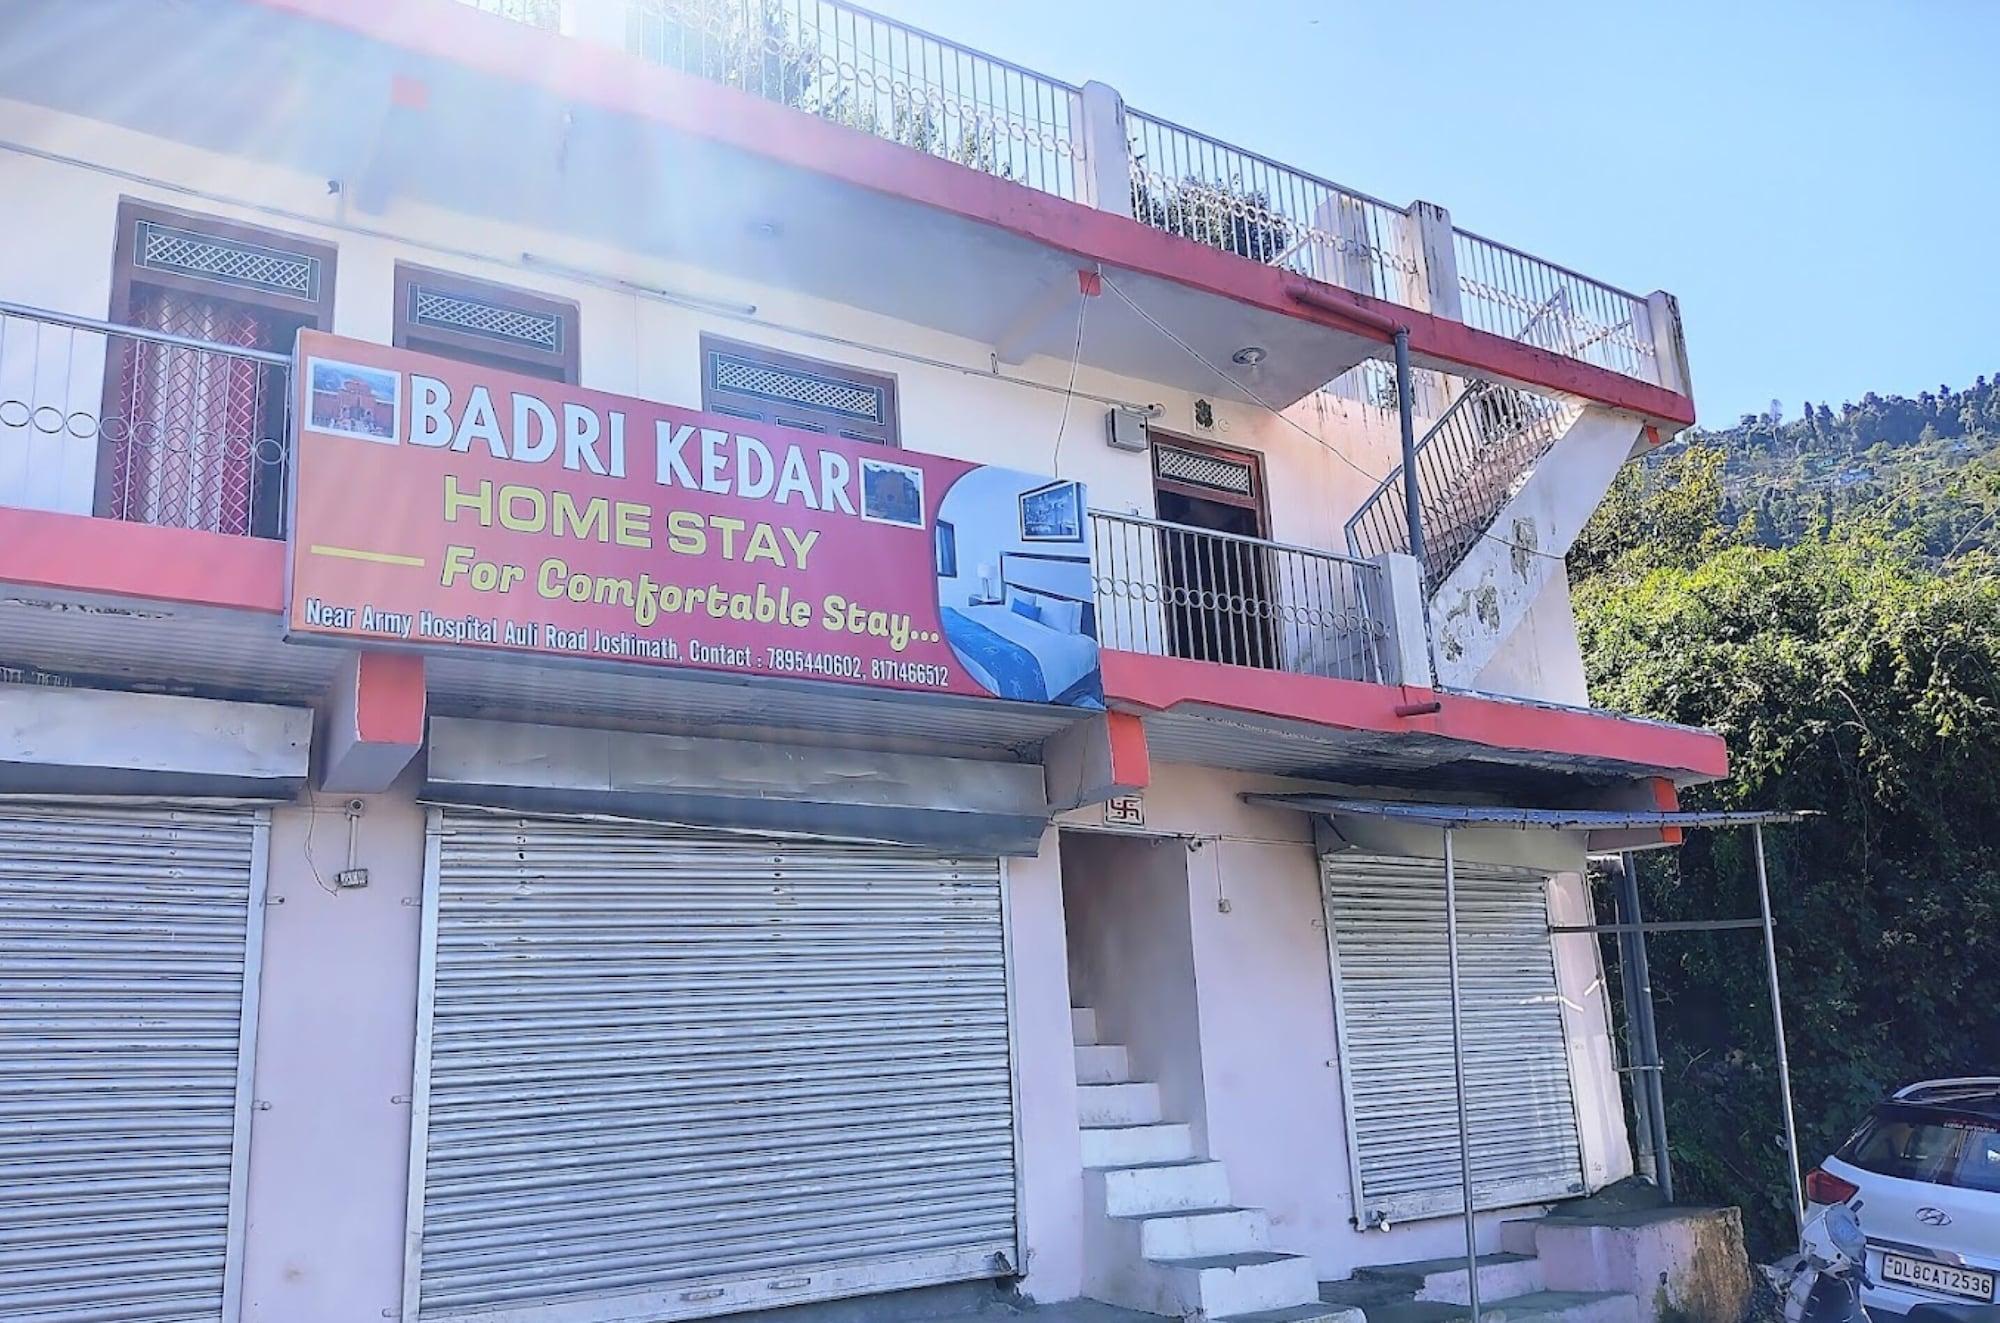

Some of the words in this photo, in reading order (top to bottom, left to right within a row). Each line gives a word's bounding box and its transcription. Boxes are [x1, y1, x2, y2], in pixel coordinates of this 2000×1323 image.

[408, 373, 626, 478] BADRI
[655, 419, 859, 516] KEDAR
[443, 475, 653, 549] HOME
[667, 510, 821, 571] STAY
[305, 598, 355, 628] Near
[361, 605, 413, 639] Army
[419, 610, 497, 644] Hospital
[503, 620, 538, 646] Auli
[545, 624, 588, 650] Road
[594, 629, 683, 662] Joshimath,
[689, 639, 751, 667] Contact
[766, 647, 867, 681] 7895440602,
[871, 658, 949, 686] 8171466512
[440, 544, 525, 593] For
[537, 558, 812, 629] Comfortable
[822, 595, 940, 651] Stay...
[1894, 1260, 1990, 1294] DL8CAT2536
